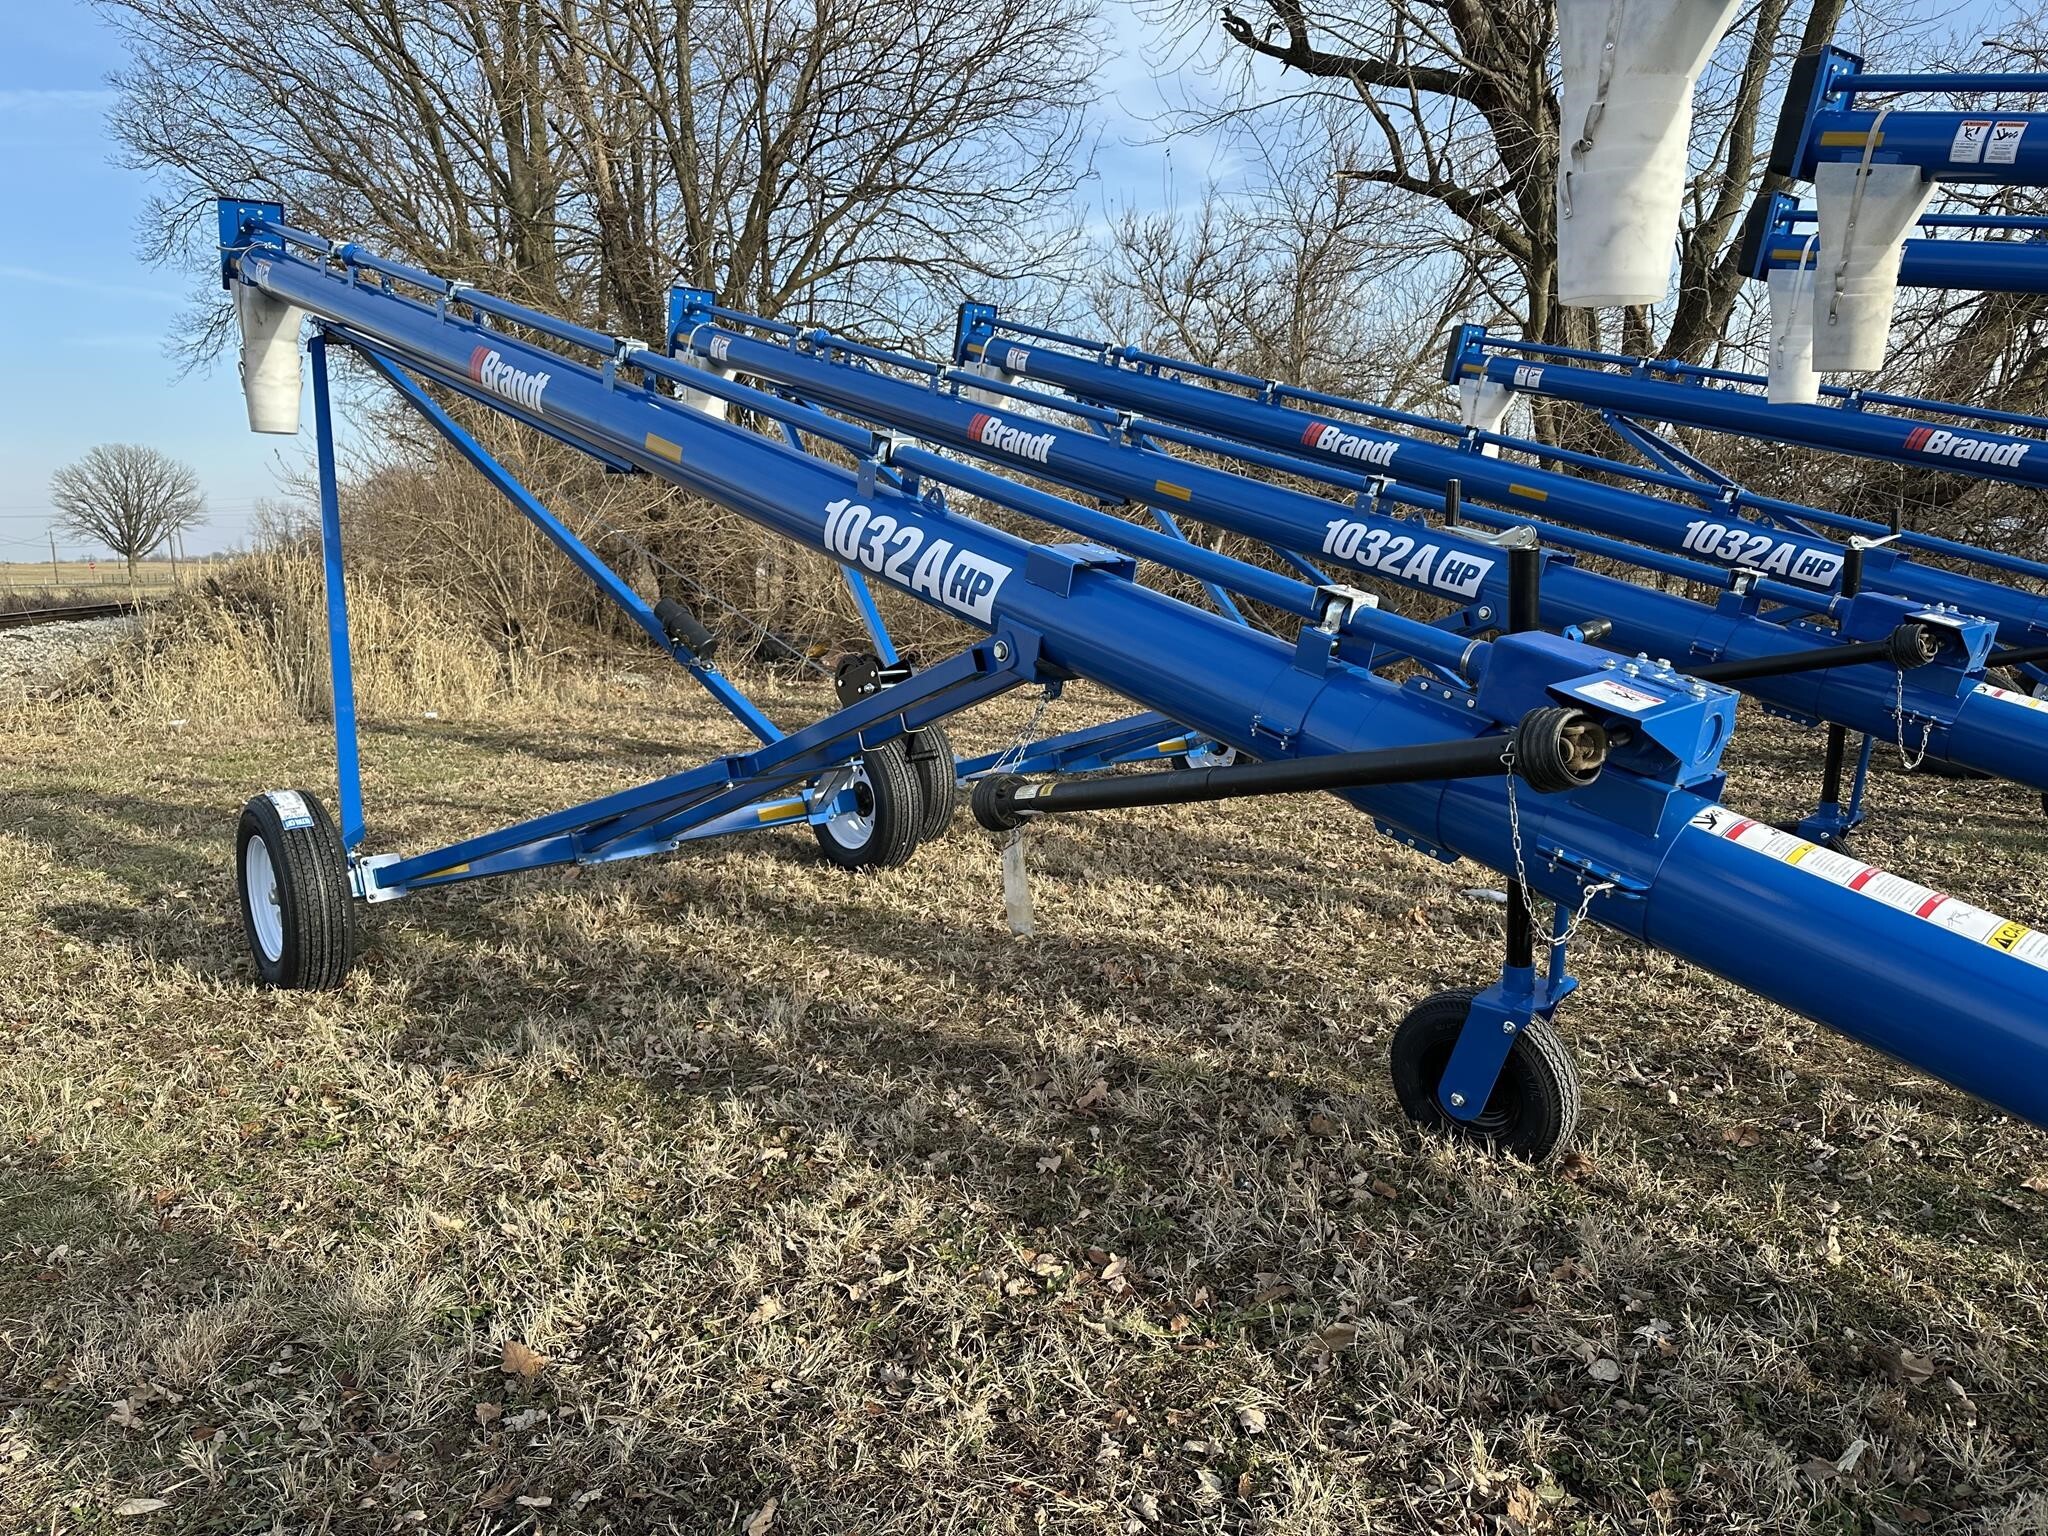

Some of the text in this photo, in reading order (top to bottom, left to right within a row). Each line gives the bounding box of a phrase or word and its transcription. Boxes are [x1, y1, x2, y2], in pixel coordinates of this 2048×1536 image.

[481, 350, 551, 414] Brandt
[981, 416, 1056, 464] Brandt
[1316, 425, 1400, 467] Brandt
[1922, 430, 2031, 468] Brandt
[823, 498, 994, 607] 1032A HP
[1322, 518, 1481, 587] 1032A HP
[1682, 520, 1836, 578] 1032A HP
